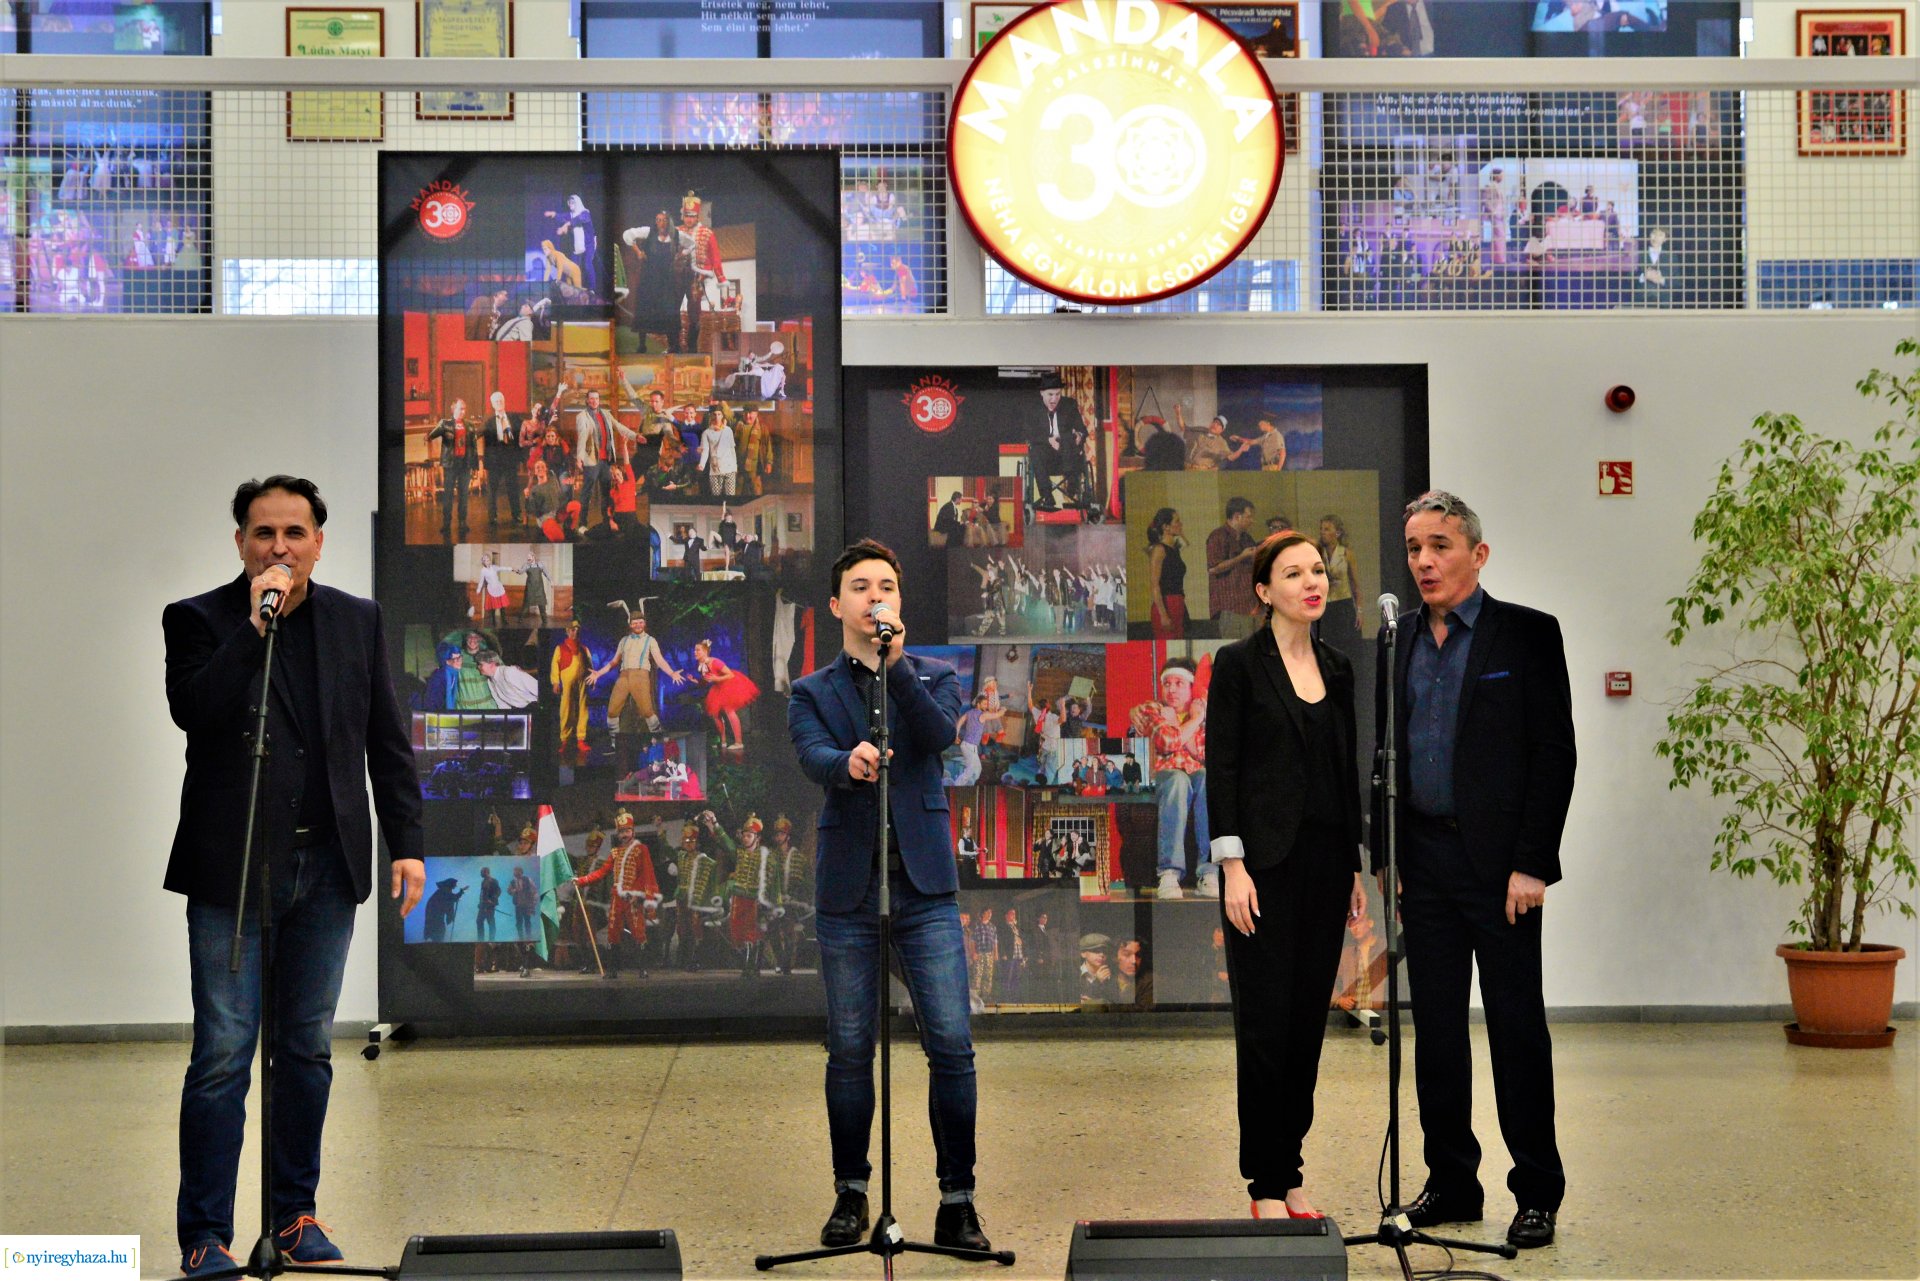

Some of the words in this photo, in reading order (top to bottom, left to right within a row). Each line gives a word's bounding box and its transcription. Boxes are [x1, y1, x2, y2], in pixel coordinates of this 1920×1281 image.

[958, 0, 1274, 144] MANDALA
[409, 180, 477, 211] MANDALA
[425, 200, 462, 228] 30
[984, 177, 1023, 245] NÉHA
[1021, 242, 1066, 280] EGY
[1068, 267, 1138, 298] ÁLOM
[1146, 231, 1230, 293] CSODÁT
[1220, 177, 1259, 233] ÍGÉR
[901, 374, 967, 406] MANDALA
[916, 395, 952, 423] 30
